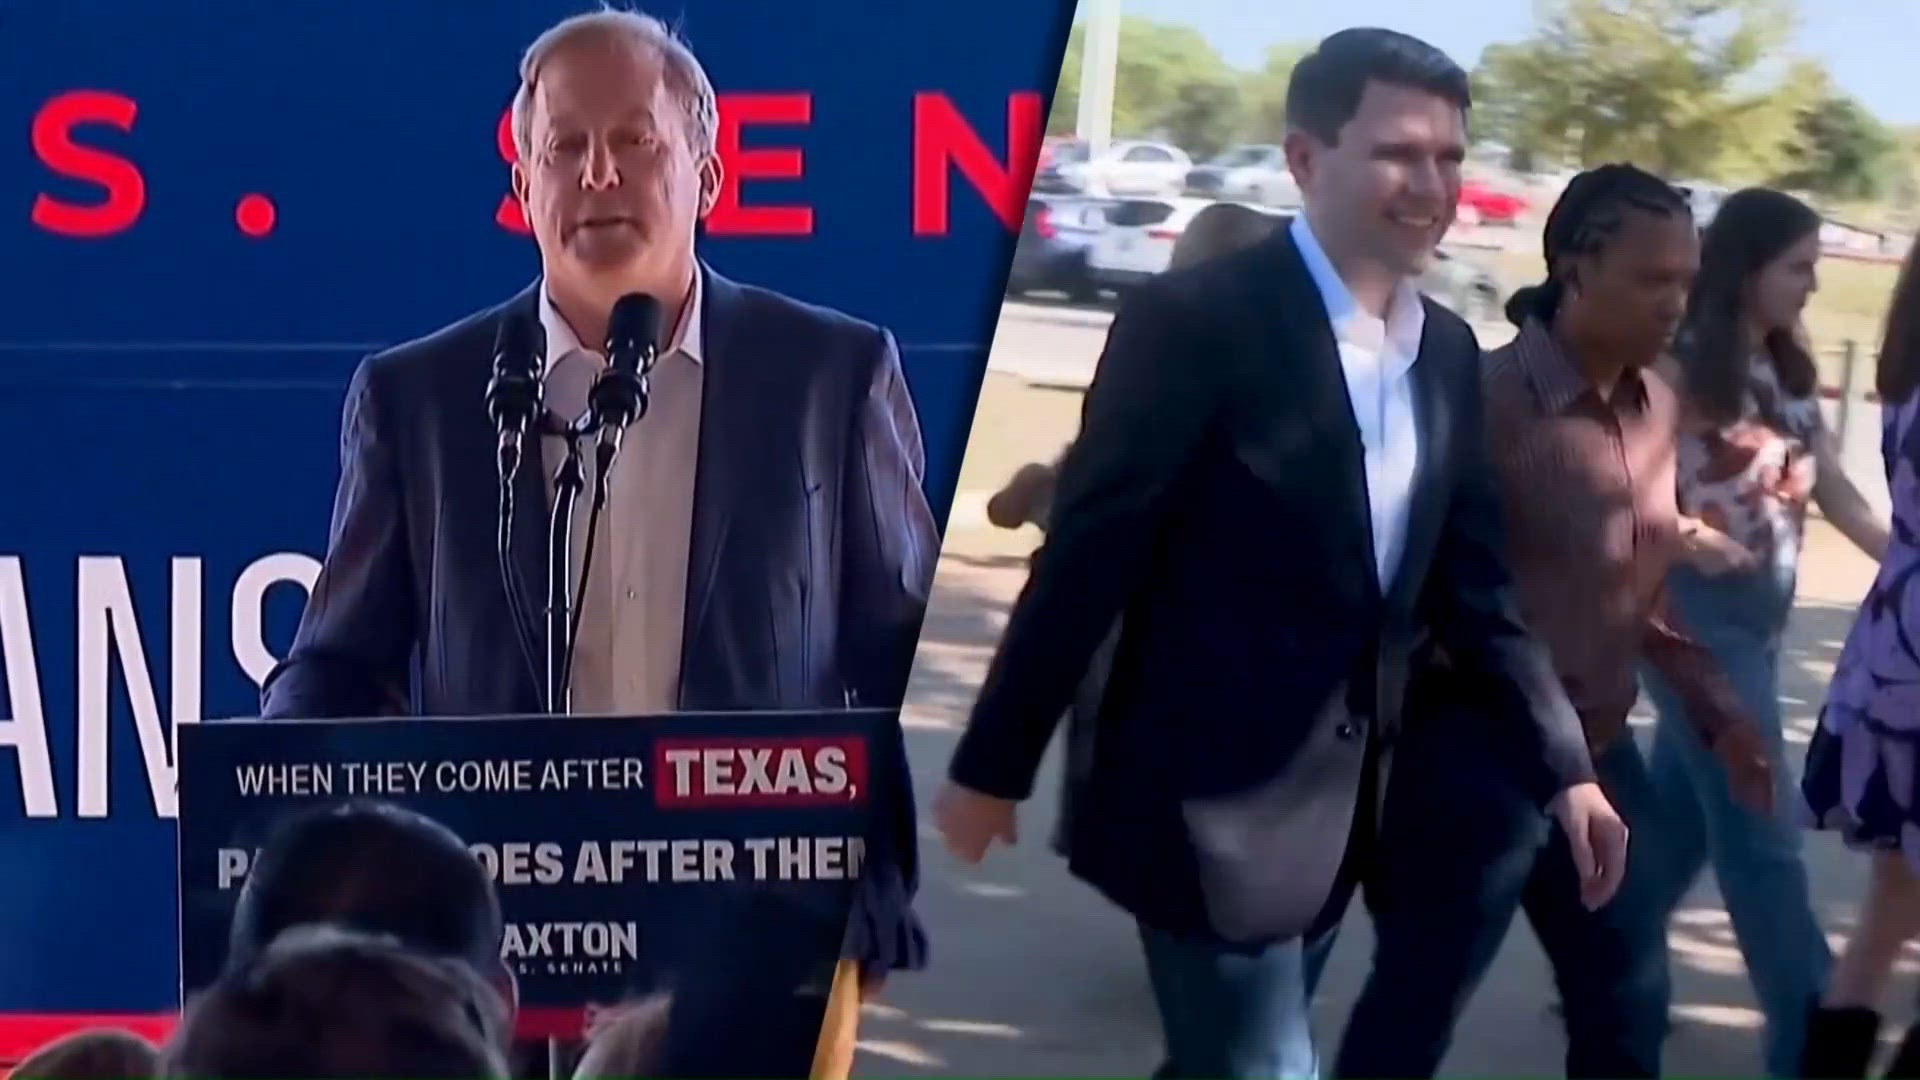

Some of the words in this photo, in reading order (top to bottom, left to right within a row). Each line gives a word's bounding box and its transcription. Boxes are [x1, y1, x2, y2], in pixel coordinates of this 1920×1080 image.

[496, 92, 1042, 235] EN
[236, 764, 333, 796] WHEN
[341, 761, 427, 795] THEY
[435, 760, 532, 792] COME
[540, 758, 644, 790] AFTER
[665, 746, 857, 800] TEXAS,
[467, 842, 564, 885] OES
[573, 840, 736, 884] AFTER
[500, 921, 637, 960] AXTON
[547, 961, 622, 975] SENATE
